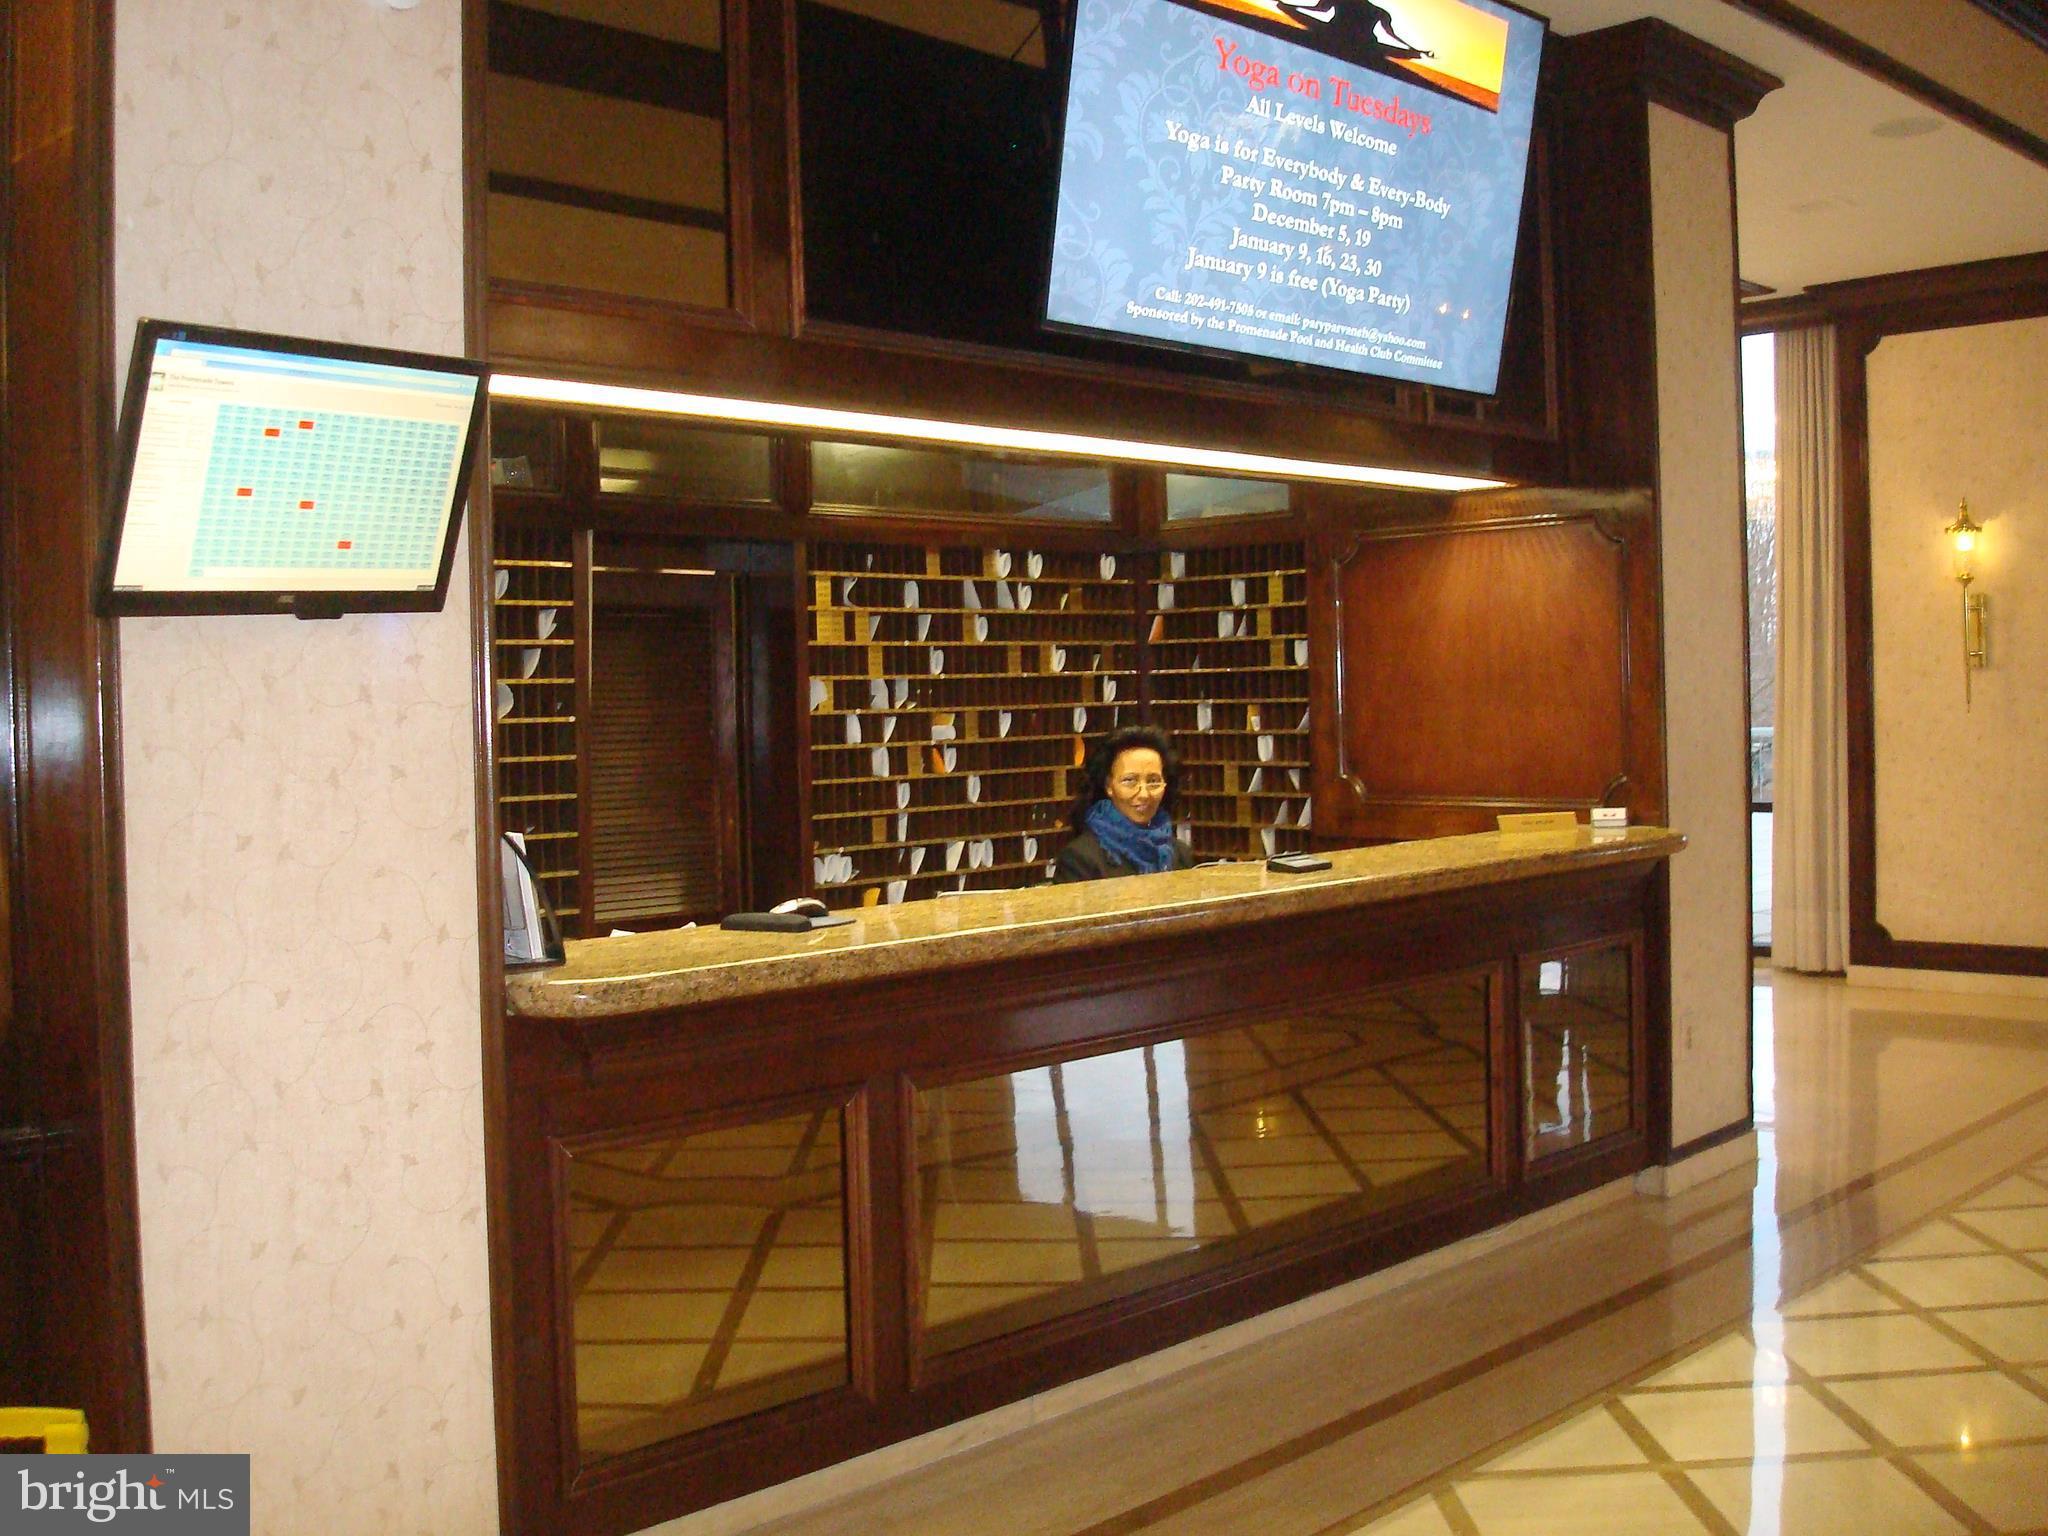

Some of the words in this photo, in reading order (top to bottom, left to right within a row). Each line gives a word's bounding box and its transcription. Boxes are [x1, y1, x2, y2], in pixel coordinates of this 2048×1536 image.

[1215, 37, 1280, 92] Yoga
[1287, 71, 1321, 99] on
[1328, 76, 1433, 138] Tuesdays
[1245, 95, 1271, 118] All
[1274, 102, 1325, 134] Levels
[1330, 119, 1397, 155] Welcome
[1166, 120, 1210, 152] Yoga
[1214, 134, 1229, 154] is
[1233, 140, 1259, 162] for
[1261, 147, 1347, 190] Everybody
[1350, 173, 1365, 191] &
[1368, 176, 1451, 219] Every-Body
[1221, 165, 1265, 198] Party
[1269, 178, 1317, 207] Room
[1322, 192, 1355, 217] 7pm
[1371, 206, 1403, 230] 8pm
[1229, 226, 1295, 262] January
[1298, 243, 1311, 265] 9,
[1316, 245, 1336, 271] 16,
[1339, 253, 1360, 276] 23,
[1364, 259, 1382, 277] 30
[1252, 203, 1335, 239] December
[1338, 224, 1351, 246] 5,
[1355, 228, 1371, 247] 19
[1155, 287, 1182, 303] Call:
[1255, 309, 1267, 319] or
[1268, 309, 1301, 326] email:
[1185, 246, 1254, 281] January
[1257, 262, 1267, 279] 9
[1270, 264, 1284, 284] is
[1288, 269, 1318, 291] free
[1321, 276, 1365, 304] (Yoga
[1367, 286, 1410, 315] Party)
[1126, 300, 1188, 324] Sponsored
[1190, 313, 1205, 329] by
[1207, 316, 1225, 330] the
[1227, 319, 1288, 341] Promenade
[1290, 330, 1313, 346] Pool
[1314, 337, 1334, 350] and
[1335, 339, 1368, 356] Health
[1370, 346, 1393, 360] Club
[1394, 350, 1443, 369] Committee
